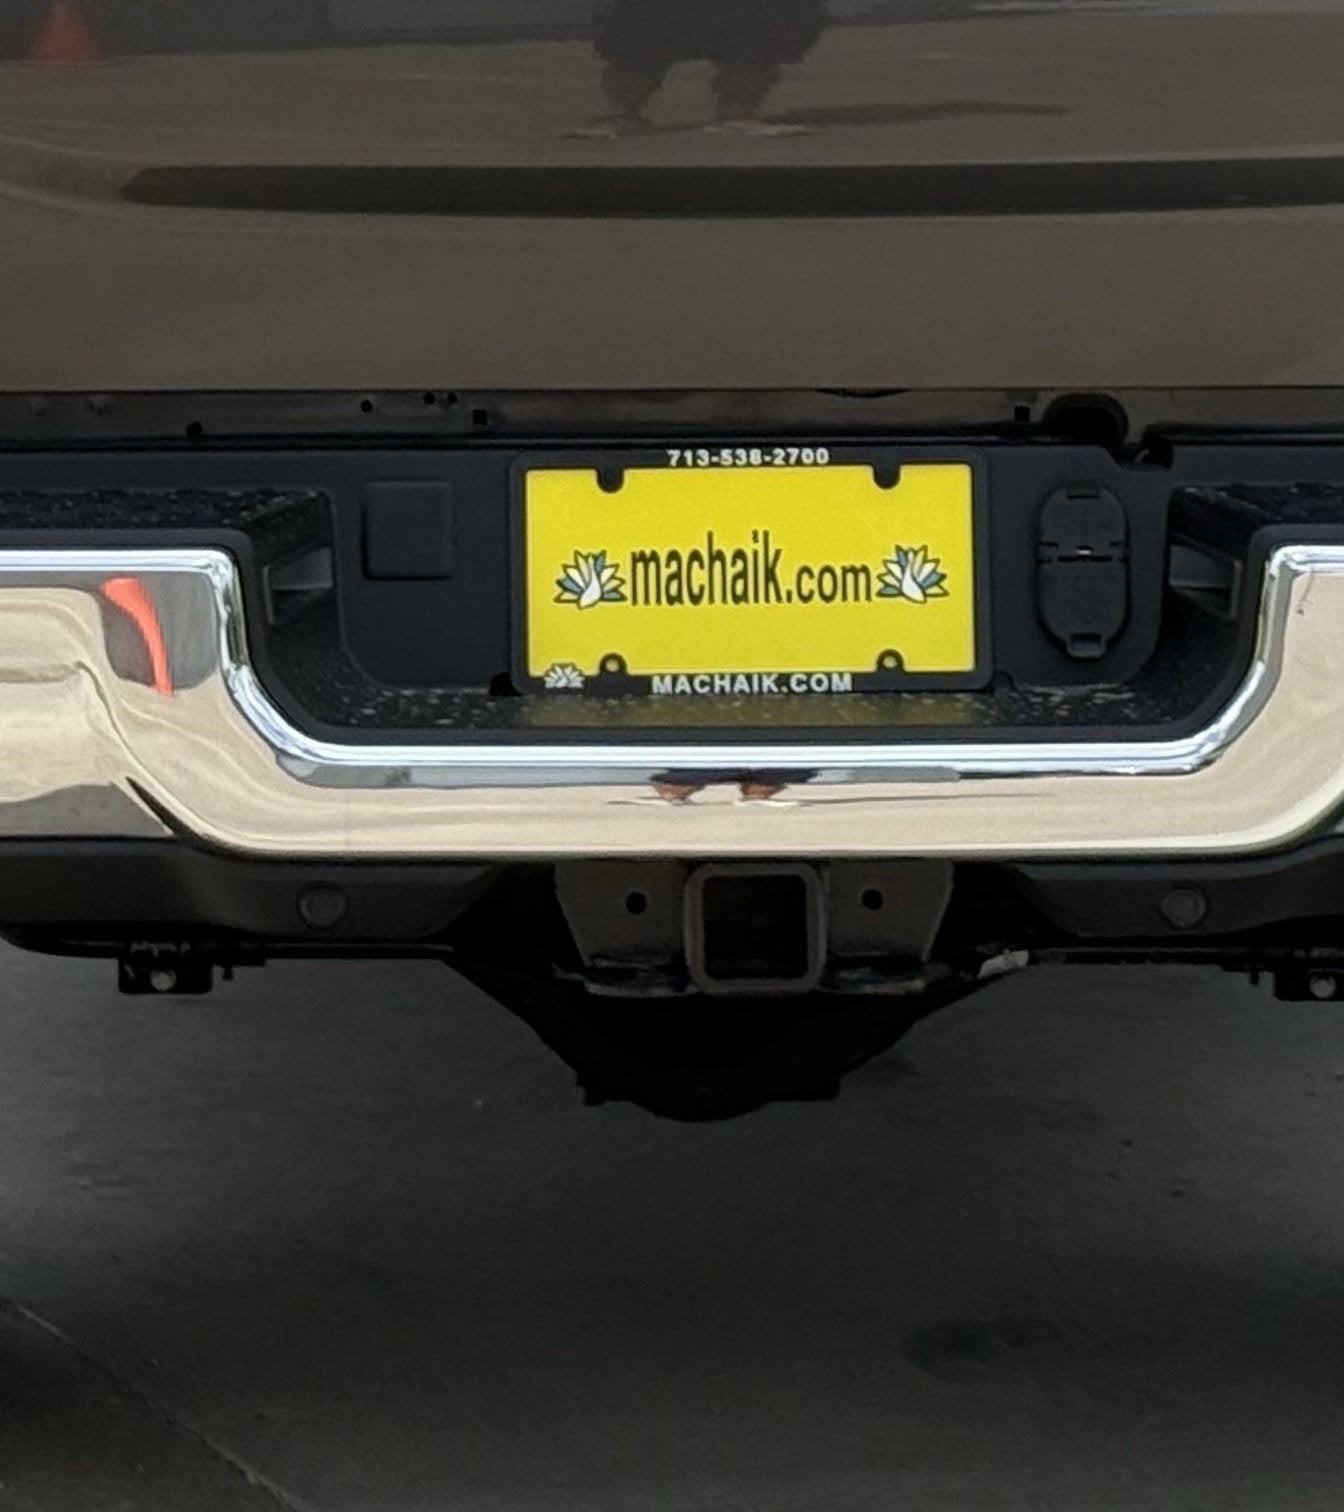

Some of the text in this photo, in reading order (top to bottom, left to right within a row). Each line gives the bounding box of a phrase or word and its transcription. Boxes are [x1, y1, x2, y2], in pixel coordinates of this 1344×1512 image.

[664, 447, 831, 468] 713-538-2700
[629, 529, 873, 607] machaik.com
[651, 671, 855, 696] MACHAIK.COM
